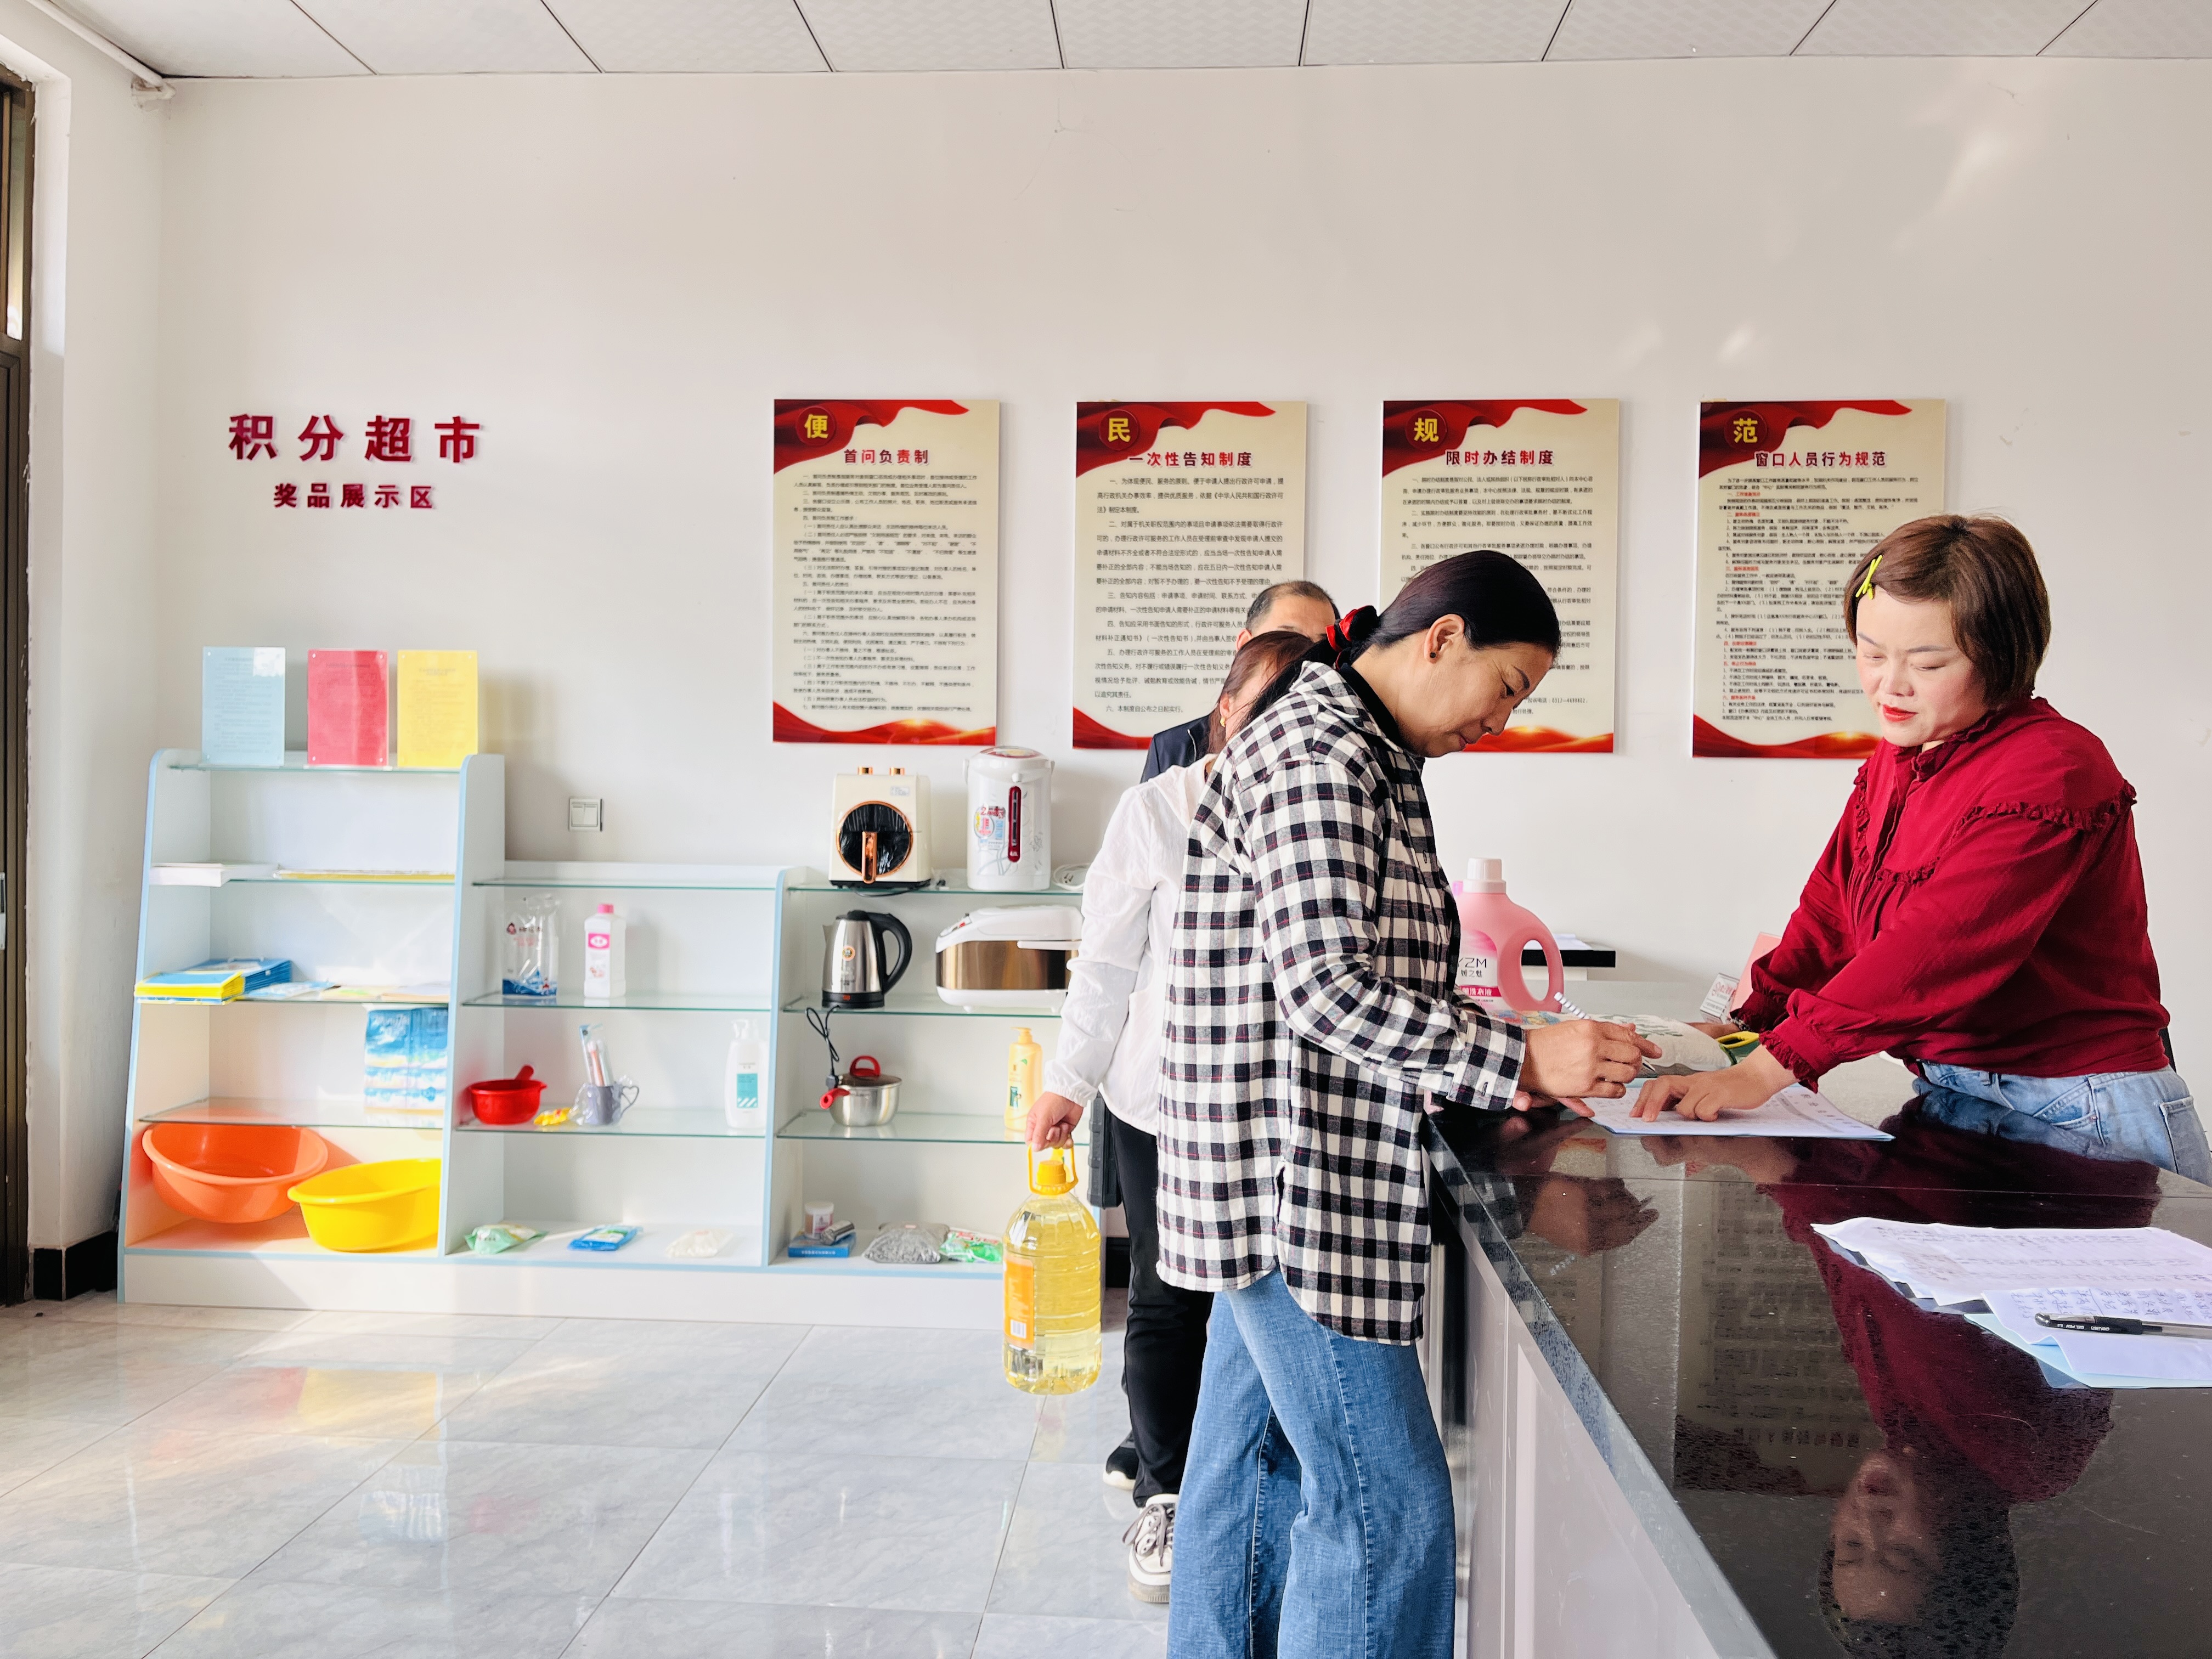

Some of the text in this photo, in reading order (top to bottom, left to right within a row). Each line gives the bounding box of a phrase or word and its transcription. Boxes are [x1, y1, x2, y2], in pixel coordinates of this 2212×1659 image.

[229, 414, 479, 462] 积分超市
[804, 414, 828, 438] 便
[1108, 418, 1131, 442] 民
[1414, 418, 1439, 442] 规
[1733, 418, 1758, 443] 范
[844, 449, 929, 464] 首问负责制
[1129, 452, 1252, 466] 一次性告知制度
[1446, 450, 1554, 465] 限时办结制度
[1756, 452, 1886, 467] 窗口人员行为规范
[274, 483, 433, 509] 奖品展示区
